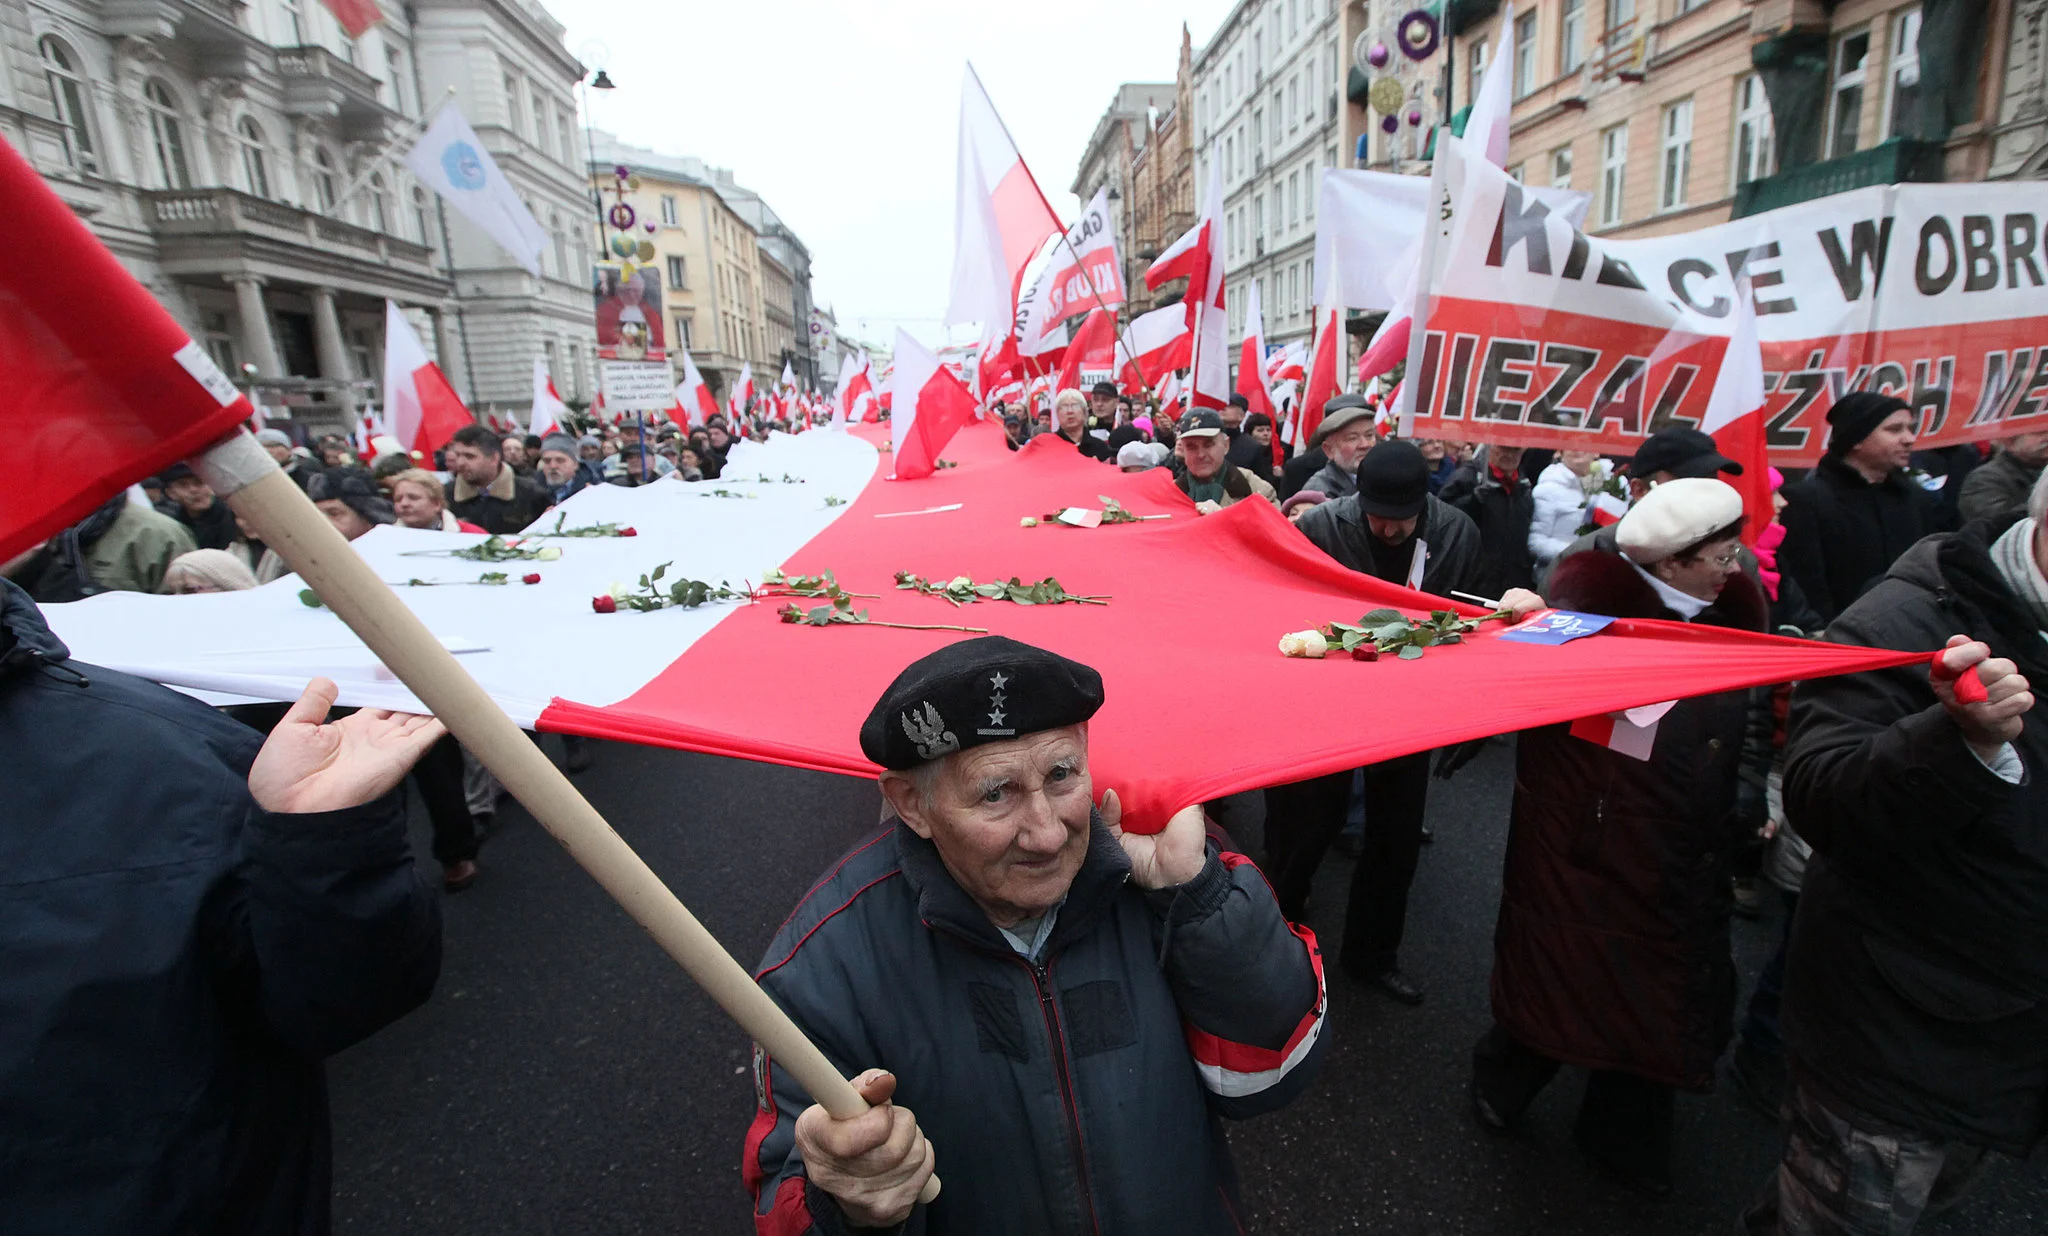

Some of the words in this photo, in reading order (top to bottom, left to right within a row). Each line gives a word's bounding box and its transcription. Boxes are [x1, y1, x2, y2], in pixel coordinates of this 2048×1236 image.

[1486, 182, 1797, 318] KICE
[1817, 216, 1895, 302] W
[1914, 213, 2048, 296] OBR
[1964, 346, 2048, 428] ME
